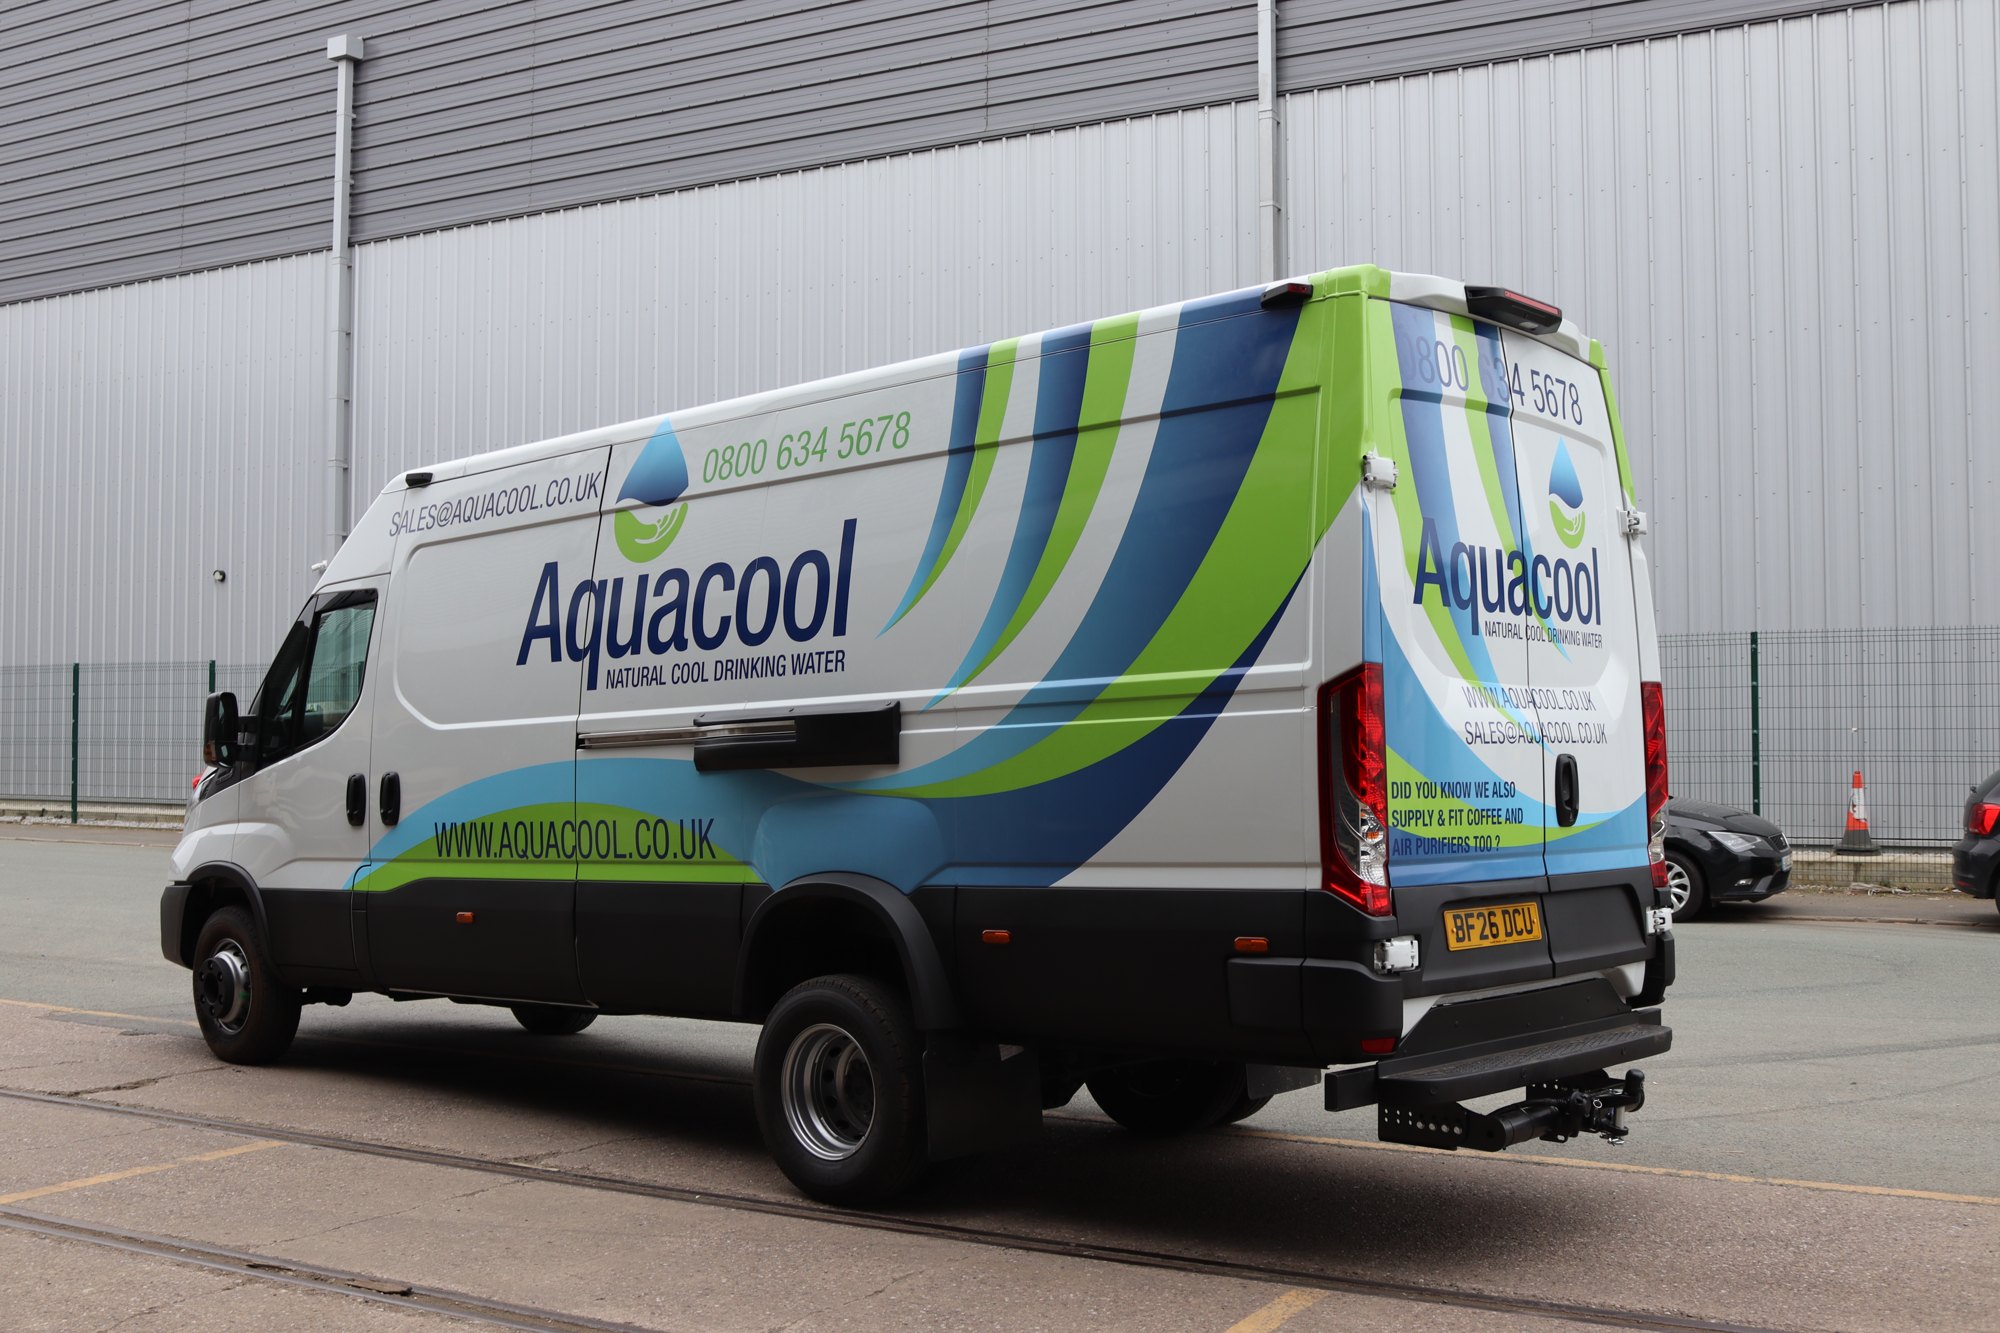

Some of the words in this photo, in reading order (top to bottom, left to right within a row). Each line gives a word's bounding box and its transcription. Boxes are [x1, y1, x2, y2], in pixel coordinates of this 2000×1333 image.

[1530, 369, 1582, 425] 5678
[703, 439, 767, 483] 0800
[776, 426, 828, 470] 634
[838, 411, 911, 459] 5678
[389, 471, 602, 537] SALES@AQUACOOL.CO.UK
[1412, 517, 1601, 636] Aquacool
[516, 519, 857, 691] Aquacool
[1485, 621, 1523, 640] NATURAL
[1525, 624, 1546, 642] COOL
[1547, 628, 1580, 646] DRINKING
[1581, 632, 1603, 648] WATER
[606, 665, 666, 689] NATURAL
[671, 661, 708, 684] COOL
[714, 655, 786, 681] DRINKING
[791, 650, 846, 676] WATER
[1461, 686, 1596, 711] WWW.AQUACOOL.CO.UK
[1464, 721, 1608, 744] SALES@AQUACOOL.CO.UK
[1391, 781, 1411, 799] DID
[1415, 781, 1437, 799] YOU
[1440, 781, 1471, 799] KNOW
[1474, 781, 1490, 798] WE
[1492, 781, 1516, 798] ALSO
[1391, 810, 1434, 827] SUPPLY
[1437, 809, 1445, 826] &
[1449, 809, 1464, 826] FIT
[1467, 808, 1502, 825] COFFEE
[1505, 808, 1523, 824] AND
[434, 818, 716, 860] WWW.AQUACOOL.CO.UK
[1392, 838, 1412, 856] AIR
[1415, 836, 1470, 855] PURIFIERS
[1473, 835, 1492, 852] TOO
[1495, 834, 1501, 851] ?
[1453, 911, 1499, 943] BF26
[1501, 907, 1534, 937] DCU
